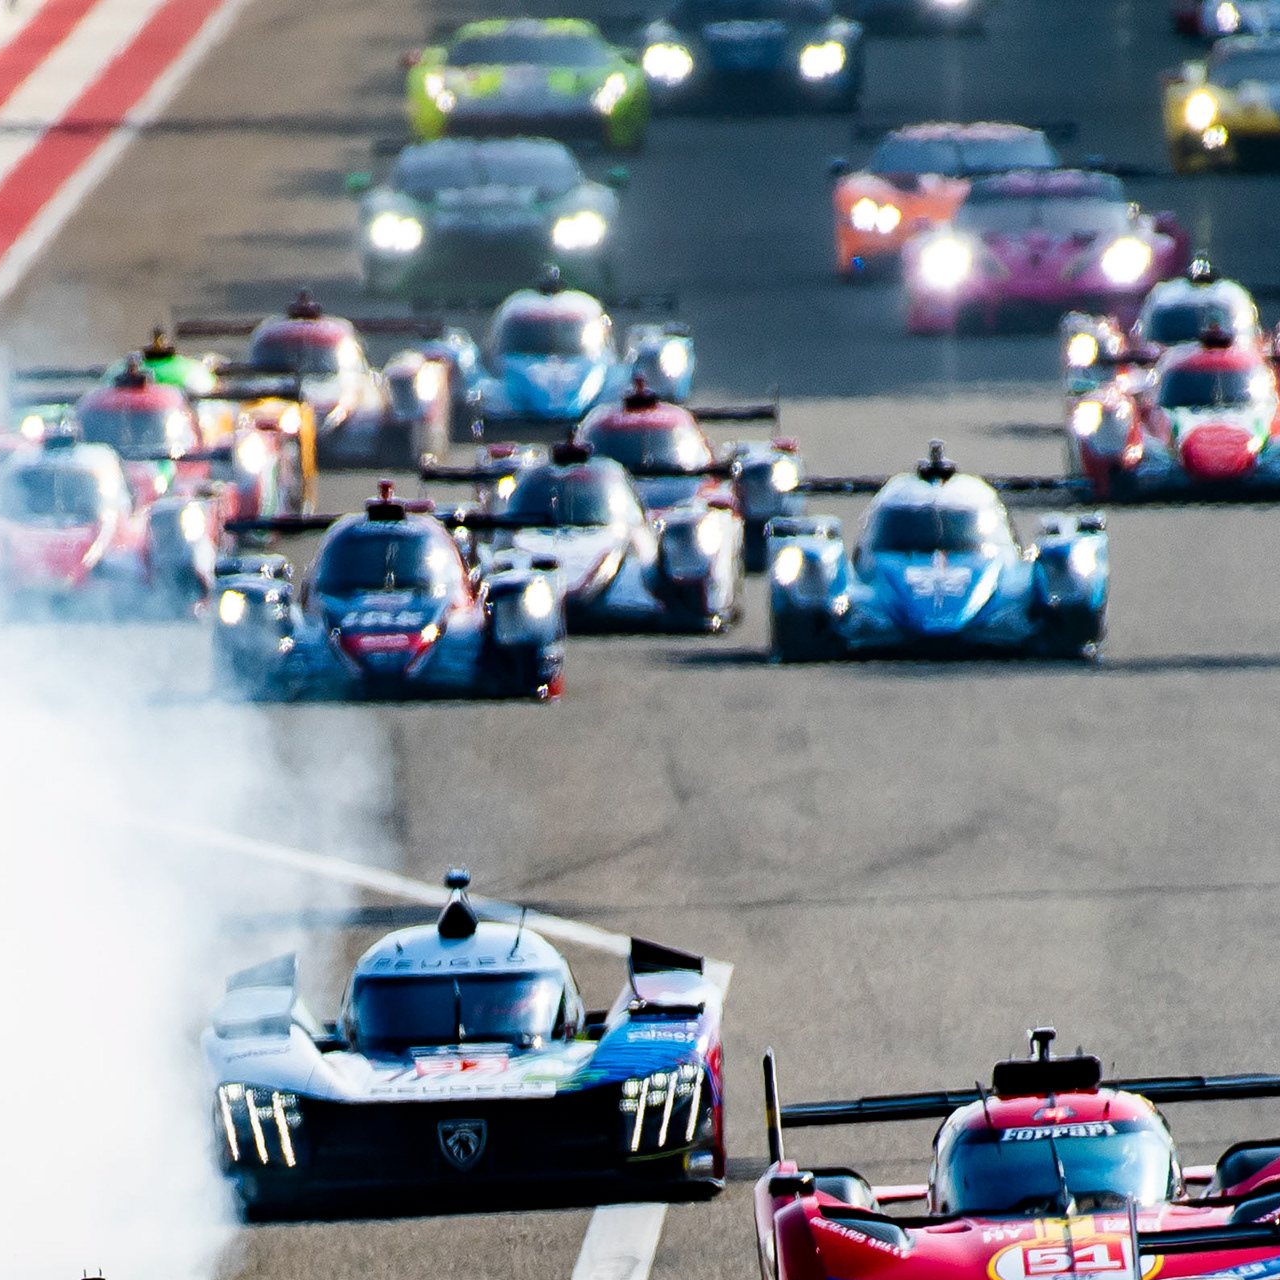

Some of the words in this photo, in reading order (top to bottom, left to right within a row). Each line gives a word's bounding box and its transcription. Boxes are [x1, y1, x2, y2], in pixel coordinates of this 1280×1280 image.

[1002, 1122, 1118, 1142] Ferrari
[983, 1227, 1025, 1244] HY
[1028, 1243, 1123, 1275] 51
